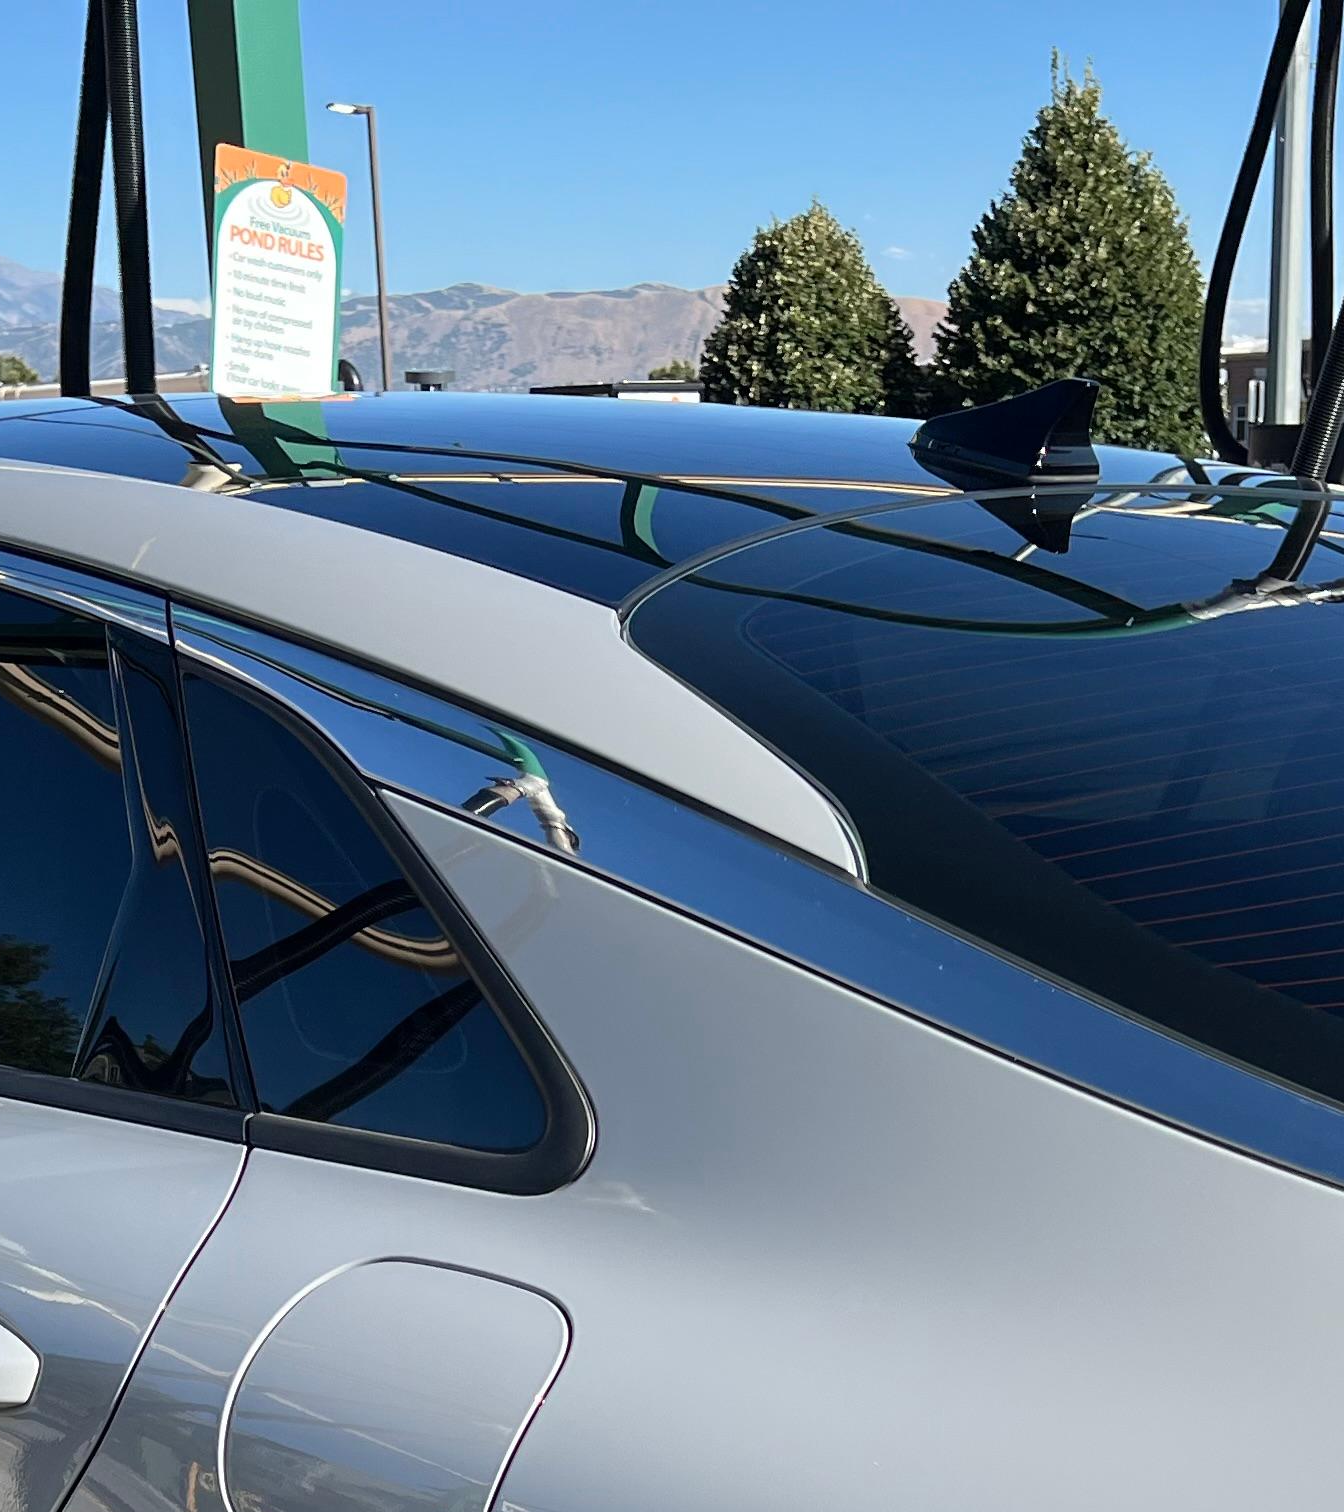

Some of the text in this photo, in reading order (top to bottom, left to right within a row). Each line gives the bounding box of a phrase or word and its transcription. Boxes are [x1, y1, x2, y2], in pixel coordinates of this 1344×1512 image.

[230, 224, 324, 262] POND RULES
[250, 216, 311, 240] Free Vacuum
